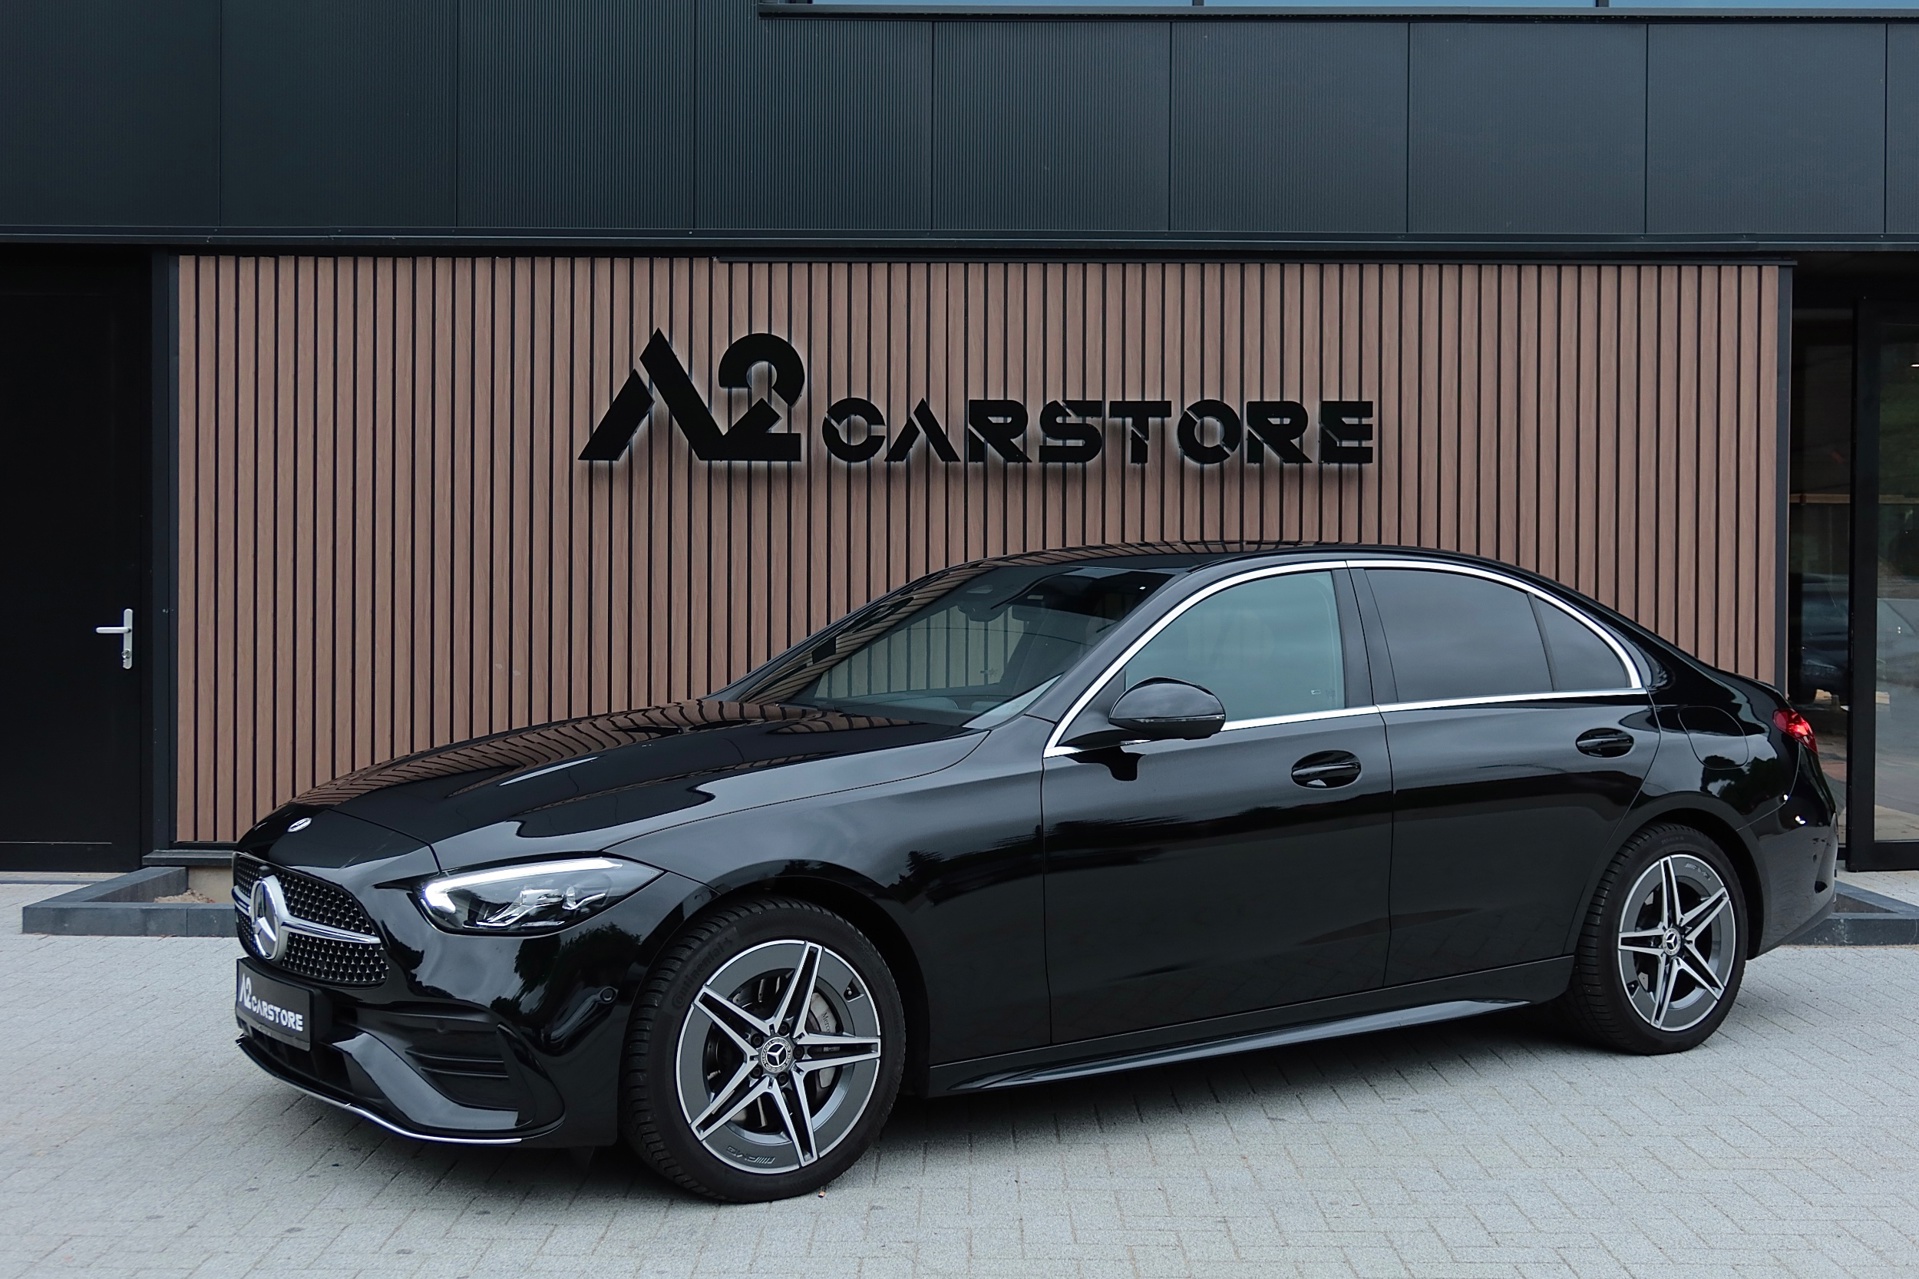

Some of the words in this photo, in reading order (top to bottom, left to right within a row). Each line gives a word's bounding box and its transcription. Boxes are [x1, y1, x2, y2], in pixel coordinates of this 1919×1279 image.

[577, 327, 806, 462] A2
[822, 396, 1375, 465] CARSTORE
[239, 973, 251, 1009] A2
[252, 996, 303, 1031] CARSTORE
